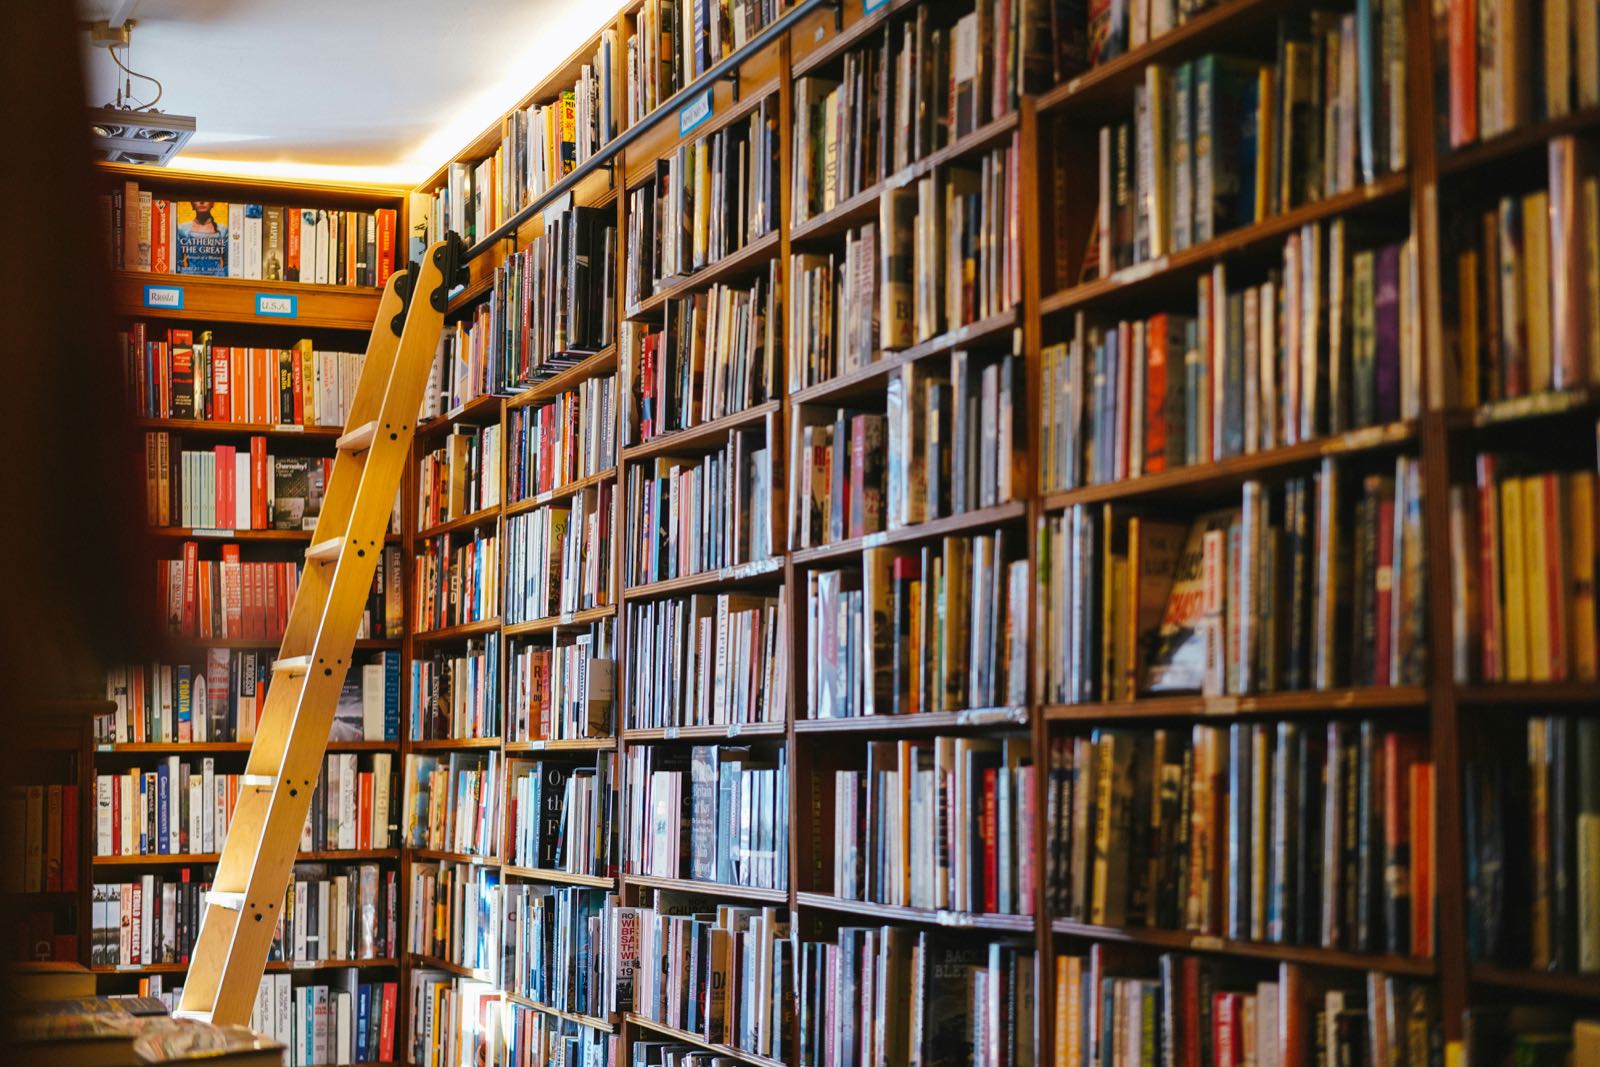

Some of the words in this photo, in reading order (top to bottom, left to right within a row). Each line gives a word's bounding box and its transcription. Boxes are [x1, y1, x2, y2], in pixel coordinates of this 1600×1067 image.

[180, 238, 226, 247] CATHERINE
[181, 246, 196, 254] THE
[199, 246, 226, 254] GREAT
[151, 292, 174, 301] Russia
[261, 300, 289, 311] U.S.A.
[214, 360, 228, 394] STALIN
[275, 462, 307, 470] Chernobyl
[717, 600, 727, 668] GALLIPOLI
[245, 654, 255, 695] MICROCOSM
[179, 679, 190, 712] CROATIA
[132, 918, 141, 957] AMERICA
[620, 967, 634, 976] 19
